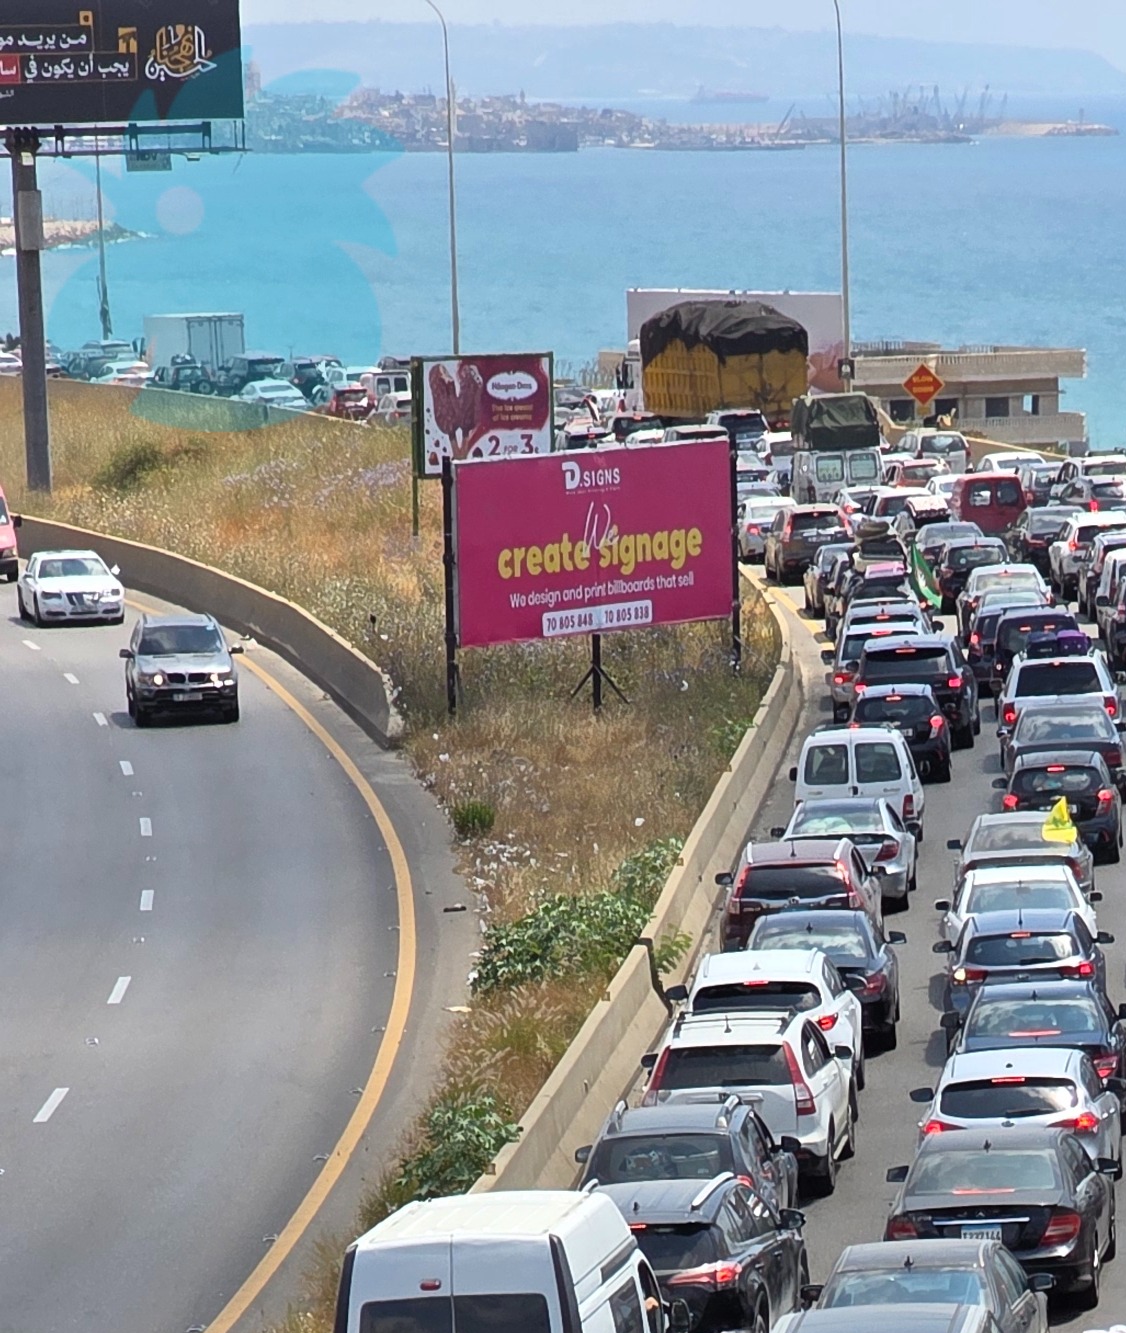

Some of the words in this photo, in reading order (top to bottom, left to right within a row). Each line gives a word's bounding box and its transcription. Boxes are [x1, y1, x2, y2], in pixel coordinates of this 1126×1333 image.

[18, 34, 56, 49] يريد
[60, 32, 87, 48] من
[41, 57, 75, 79] يكون
[77, 52, 94, 77] أن
[98, 61, 129, 77] يجب
[488, 435, 501, 456] 2
[498, 532, 590, 580] create
[599, 524, 702, 576] signage
[509, 593, 527, 608] We
[527, 587, 561, 607] design
[563, 584, 583, 601] and
[584, 582, 606, 603] print
[607, 576, 655, 596] billboards
[656, 573, 677, 589] that
[678, 571, 695, 586] sell
